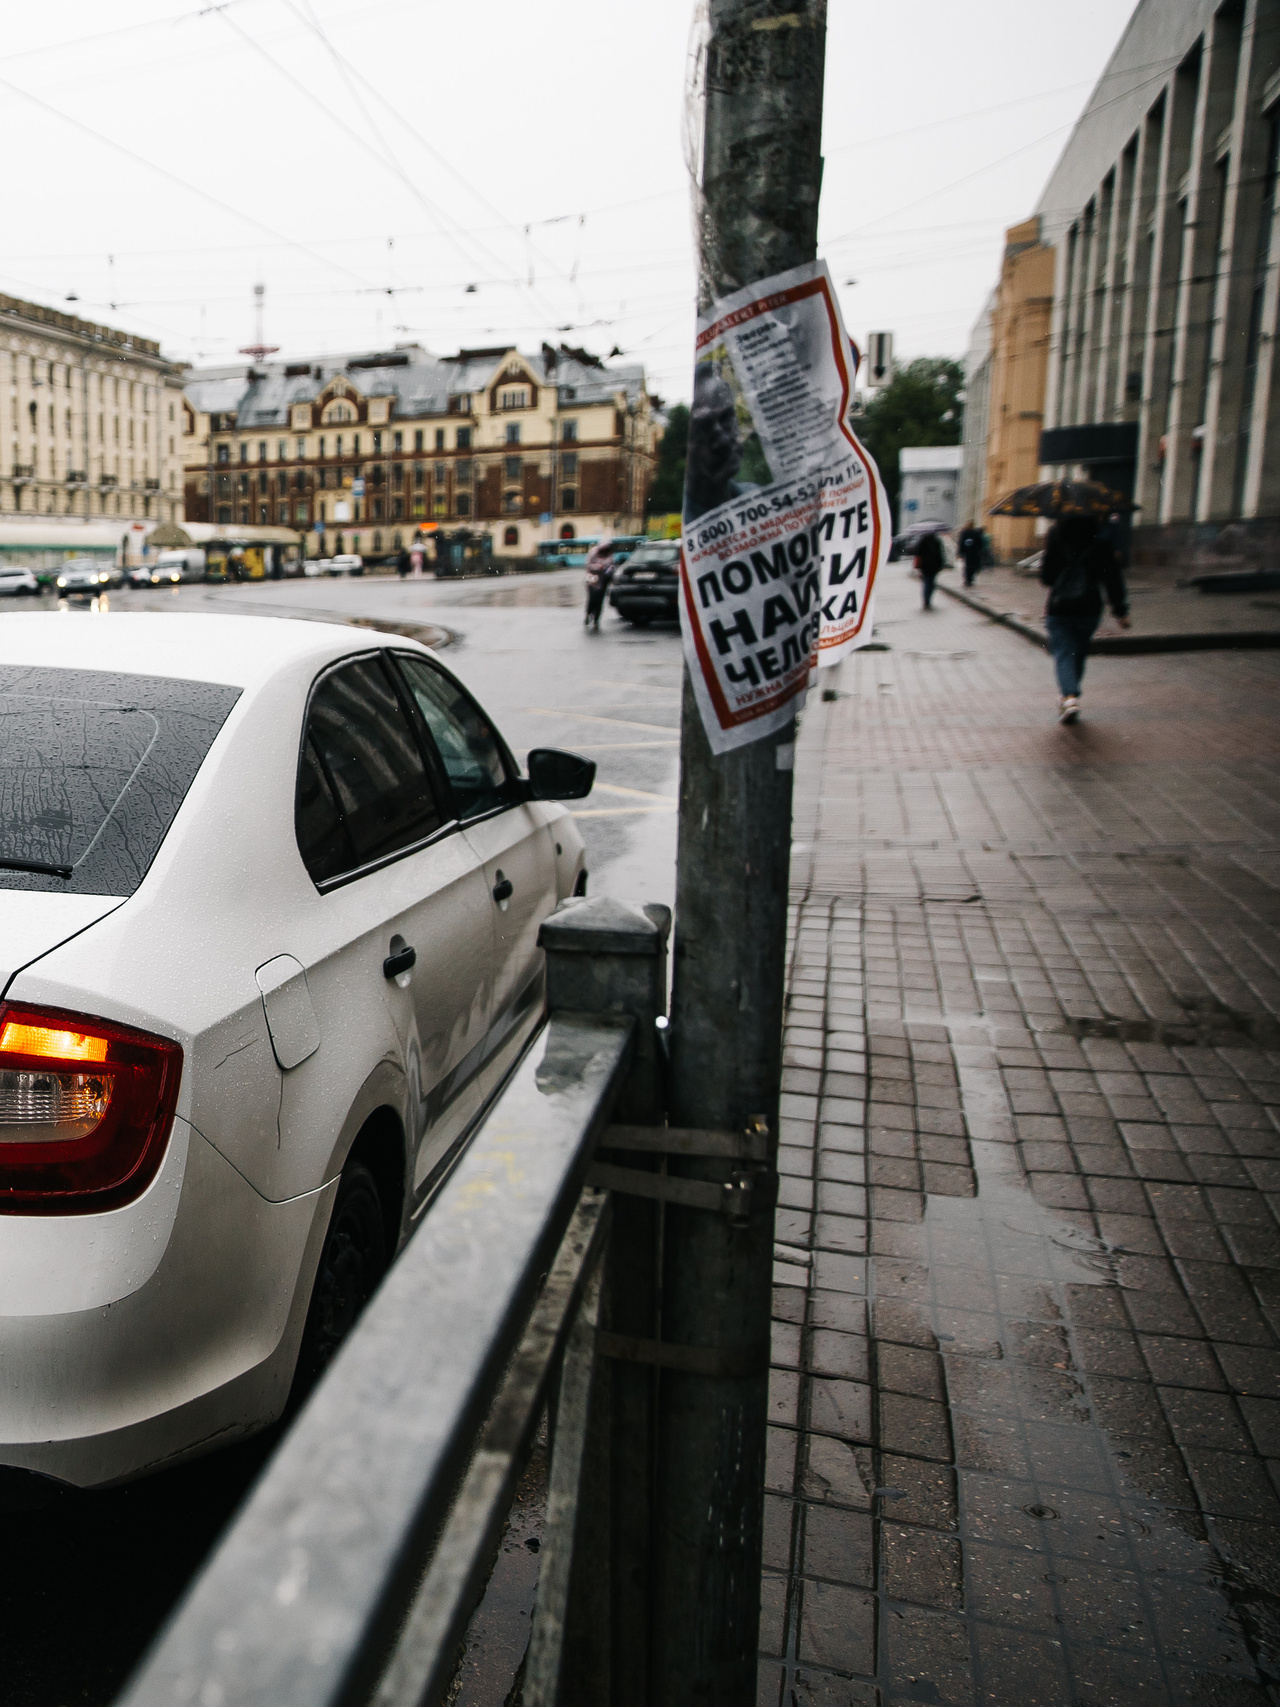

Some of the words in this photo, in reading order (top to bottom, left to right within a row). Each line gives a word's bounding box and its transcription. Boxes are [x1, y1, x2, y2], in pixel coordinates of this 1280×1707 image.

[687, 538, 695, 552] 8
[698, 518, 734, 548] (800)
[718, 527, 783, 560] ВОЗМОЖНА
[708, 545, 868, 656] НАЙИ
[735, 681, 783, 706] НУЖНА
